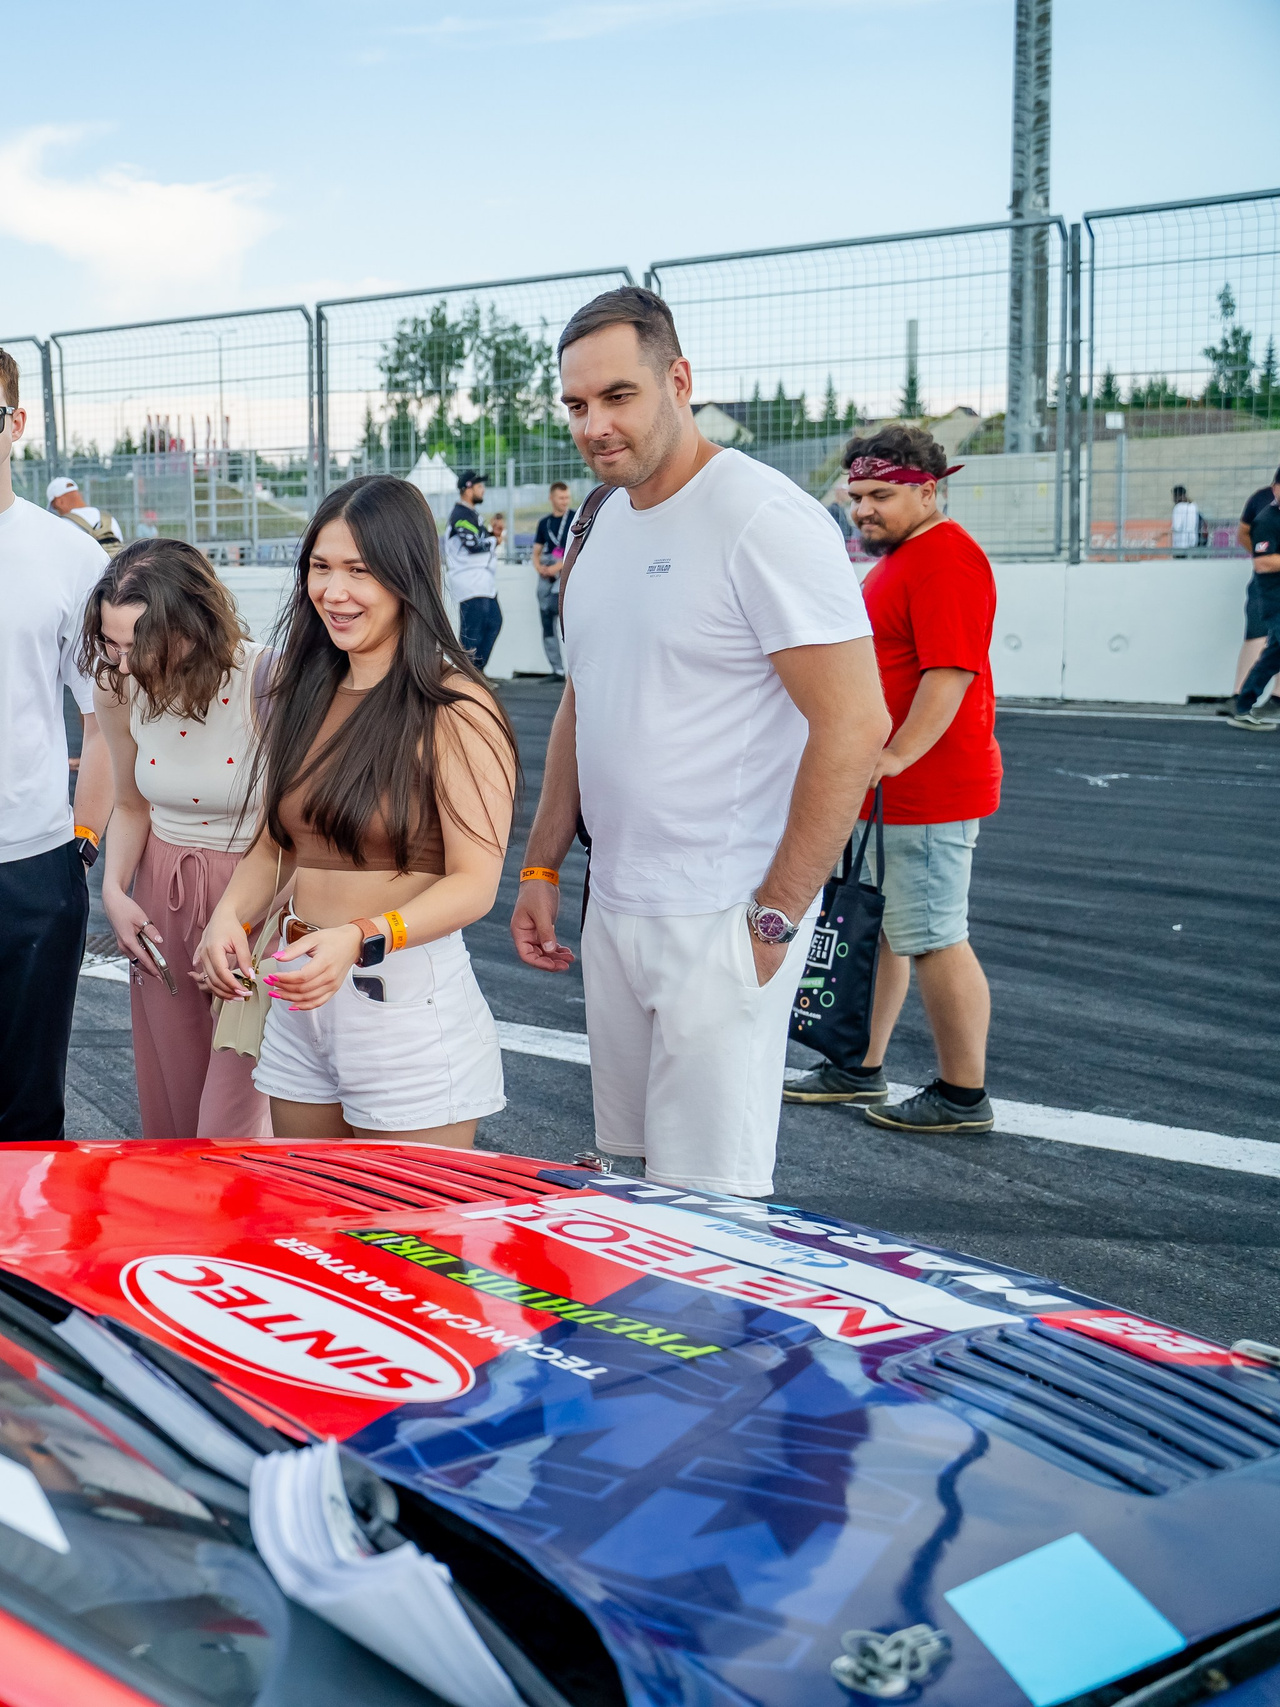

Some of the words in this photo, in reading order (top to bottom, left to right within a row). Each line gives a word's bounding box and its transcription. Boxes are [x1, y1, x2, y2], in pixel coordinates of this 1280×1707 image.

[273, 1236, 414, 1302] PARTNER
[588, 1176, 1072, 1306] MARSHALL
[154, 1265, 443, 1390] SINTEC
[415, 1300, 608, 1379] TECHNICAL
[447, 1269, 722, 1361] PREDATOR
